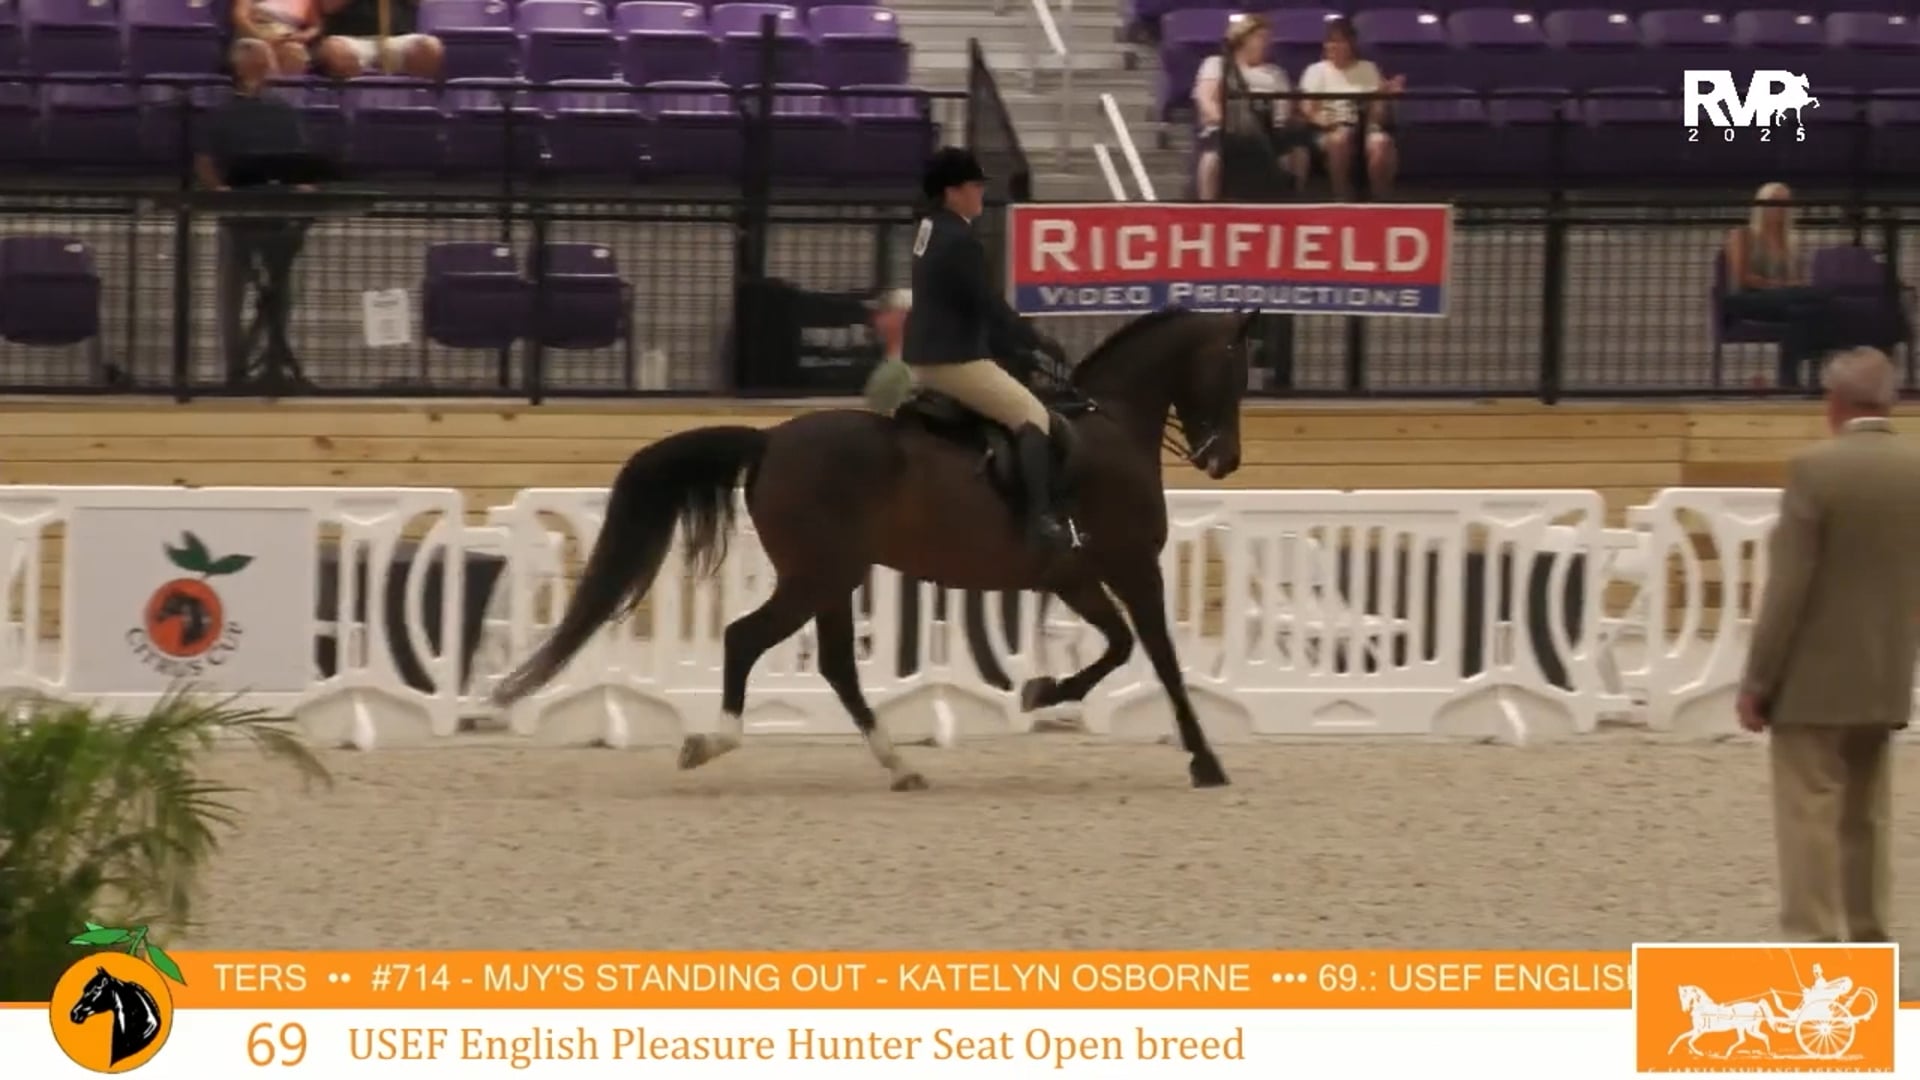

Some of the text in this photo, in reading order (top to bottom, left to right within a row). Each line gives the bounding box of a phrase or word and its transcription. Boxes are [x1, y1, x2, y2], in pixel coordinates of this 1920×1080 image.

[1030, 218, 1430, 273] RICHFIELD
[1038, 282, 1421, 308] VIDEO PRODUCTIONS
